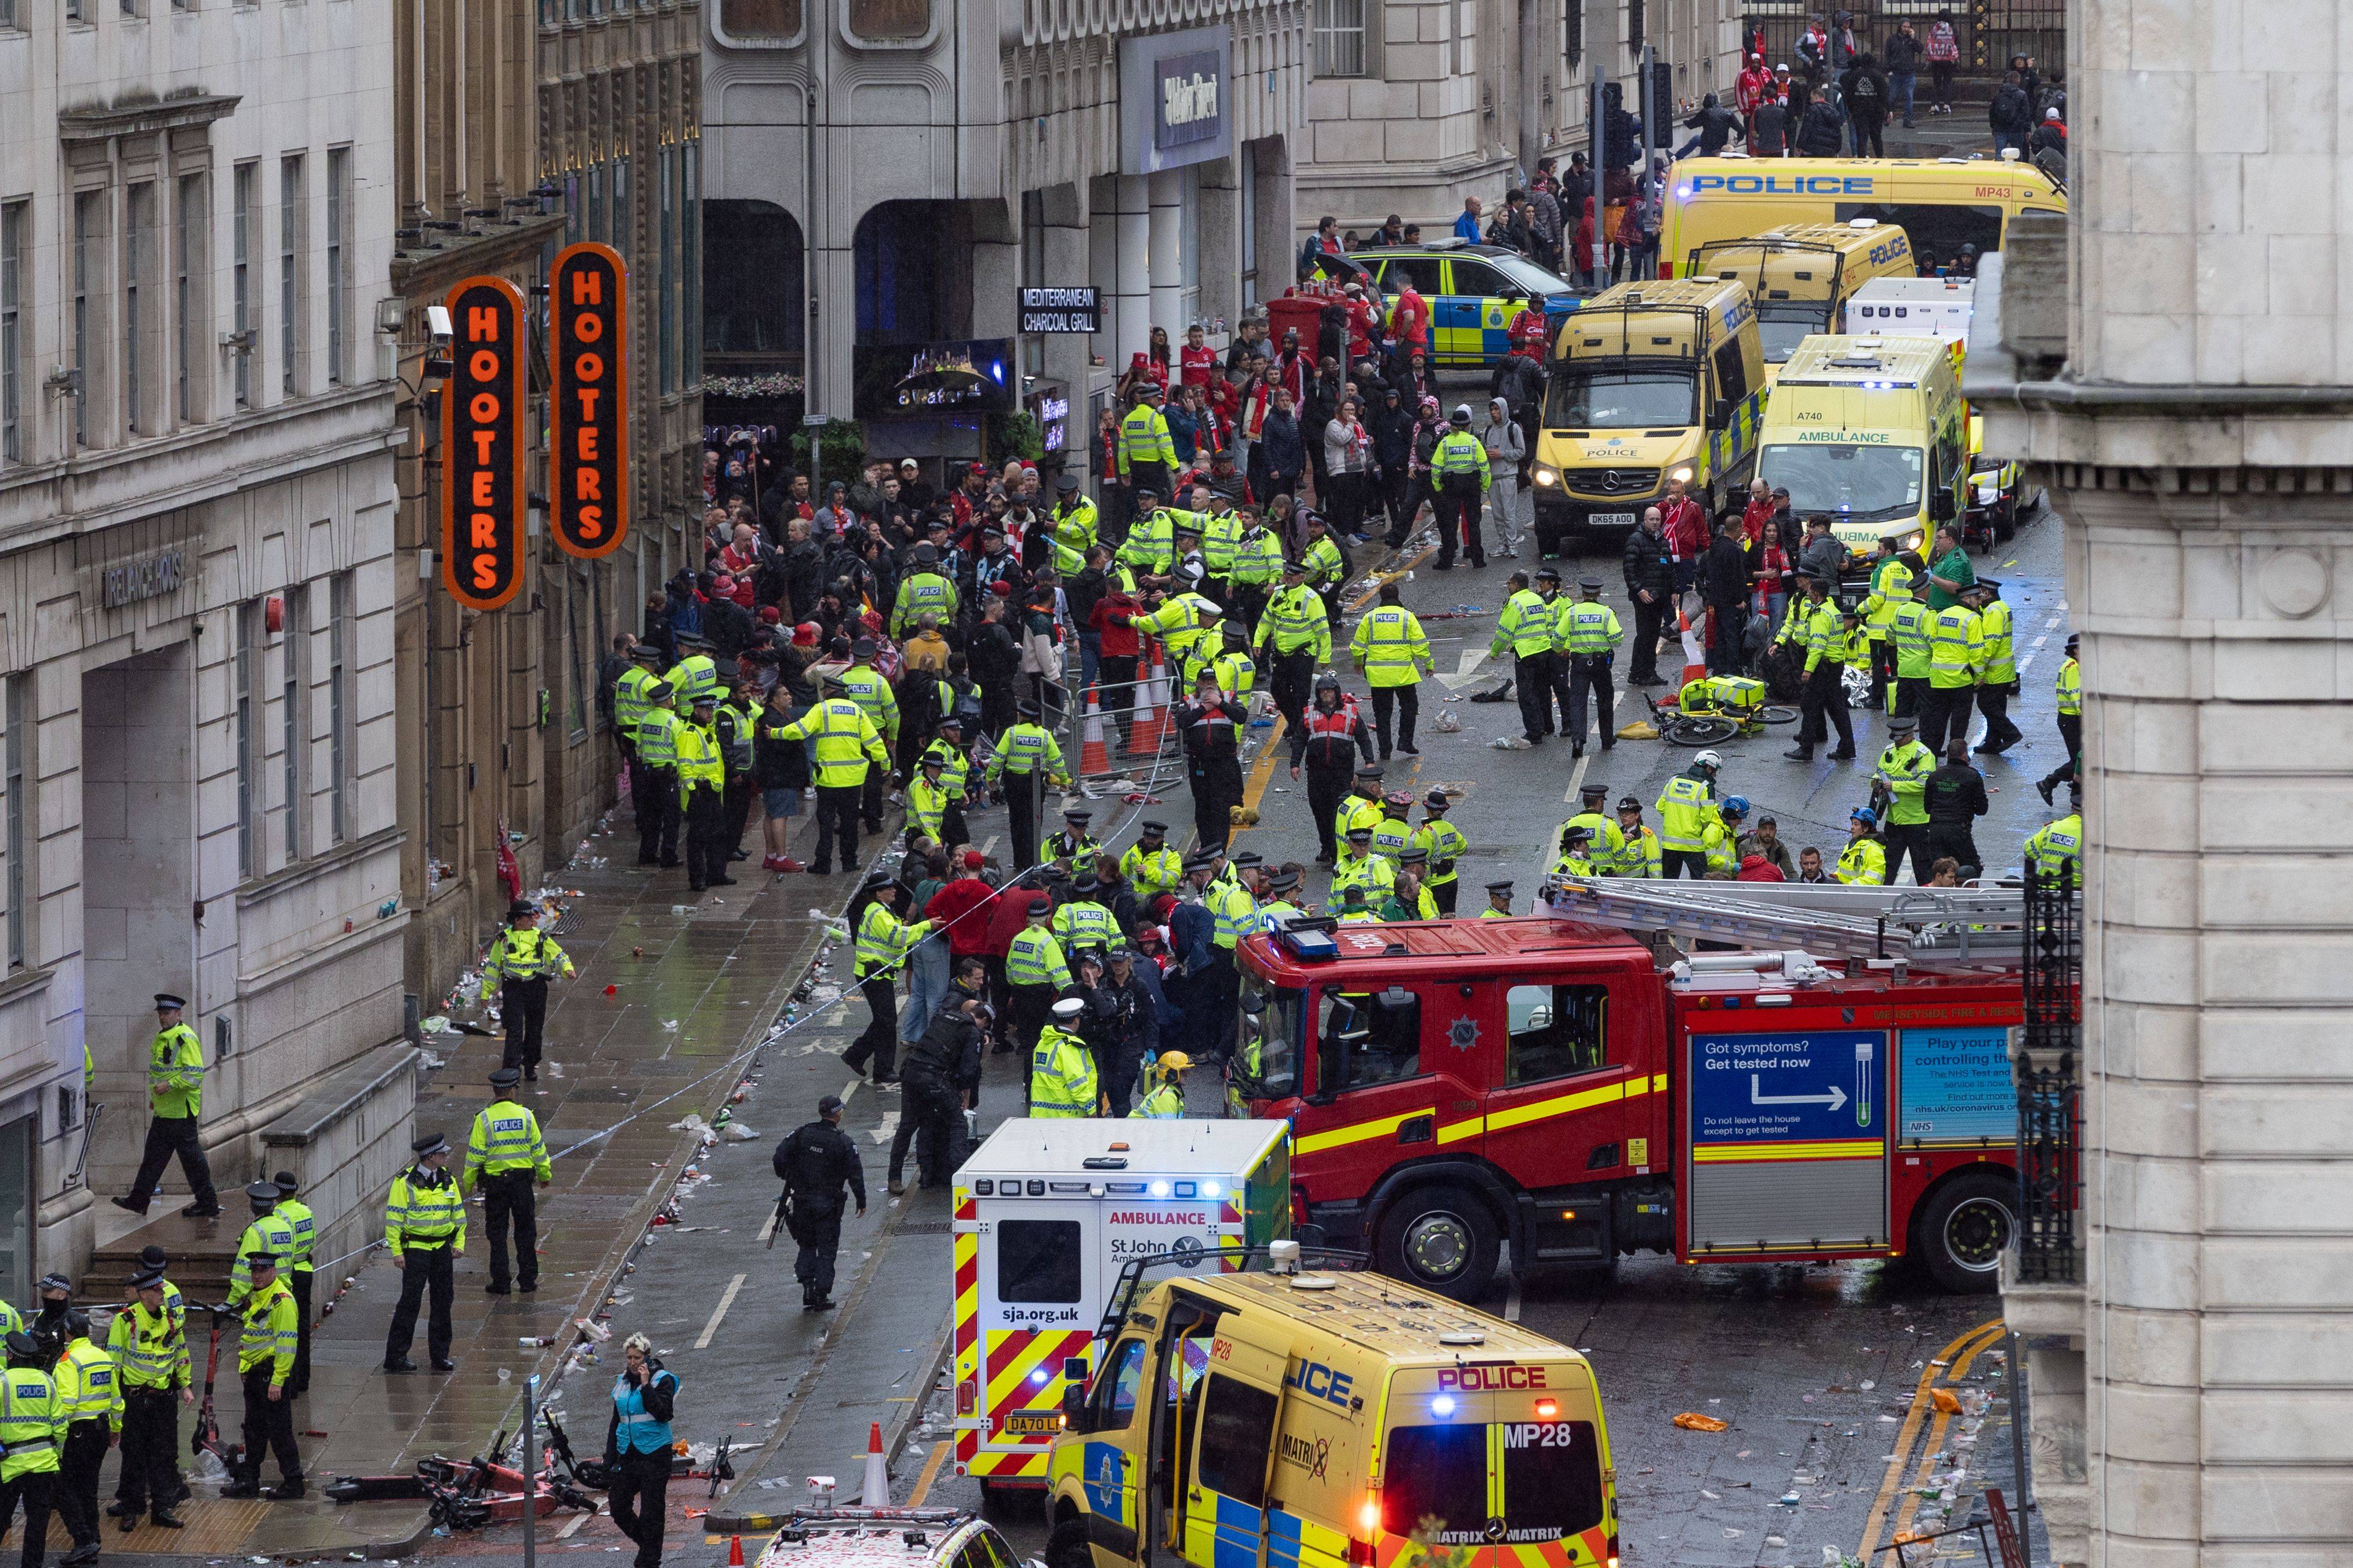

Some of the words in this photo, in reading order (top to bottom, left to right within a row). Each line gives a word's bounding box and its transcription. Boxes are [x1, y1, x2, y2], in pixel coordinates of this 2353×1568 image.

[1692, 176, 1873, 194] POLICE
[1975, 187, 2010, 198] MP43
[1869, 236, 1907, 268] POLICE
[1024, 289, 1094, 306] MEDITERRANEAN
[1724, 298, 1752, 333] POLICE
[1024, 313, 1069, 331] CHARCOAL
[1071, 313, 1095, 331] GRILL
[912, 388, 965, 405] Water
[573, 271, 604, 539] HOOTERS
[1798, 432, 1889, 443] AMBULANCE
[469, 306, 500, 590] HOOTERS
[1592, 515, 1613, 524] DK65
[918, 587, 940, 596] POLICE
[1528, 605, 1544, 614] POLICE
[1899, 617, 1913, 626] POLICE
[1941, 617, 1958, 627] POLICE
[1241, 663, 1252, 671] POLICE
[696, 670, 714, 680] POLICE
[642, 725, 662, 734] POLICE
[1018, 736, 1041, 746] POLICE
[1378, 835, 1403, 847] POLICE
[2051, 834, 2075, 846] POLICE
[1078, 911, 1102, 920] POLICE
[1015, 941, 1034, 953] POLICE
[1874, 1009, 1948, 1020] MERSEYSIDE
[1952, 1008, 1976, 1018] FIRE
[1980, 1007, 1987, 1016] &
[1990, 1006, 2024, 1017] RESC
[1705, 1043, 1729, 1054] Got
[1733, 1041, 1809, 1056] symptoms?
[1928, 1038, 1956, 1050] Play
[1961, 1039, 1992, 1050] your
[1705, 1058, 1730, 1069] Get
[1734, 1057, 1777, 1069] tested
[1781, 1059, 1810, 1068] now
[1915, 1054, 1989, 1066] controlling
[1944, 1080, 1974, 1089] service
[1948, 1093, 1967, 1101] Find
[1915, 1104, 2005, 1113] nhs.uk/coronavirus
[494, 1120, 522, 1132] POLICE
[1704, 1127, 1733, 1136] except
[1746, 1127, 1759, 1135] get
[1762, 1126, 1788, 1134] tested
[1911, 1122, 1931, 1130] NHS
[1110, 1213, 1205, 1224] AMBULANCE
[272, 1233, 291, 1244] POLICE
[1111, 1239, 1128, 1253] St
[1130, 1239, 1167, 1253] John
[1003, 1307, 1079, 1320] sja.org.uk
[1211, 1337, 1232, 1360] MP28
[1437, 1367, 1546, 1391] POLICE
[17, 1386, 46, 1397] POLICE
[1011, 1419, 1043, 1431] DA70
[1504, 1424, 1571, 1448] MP28
[1282, 1430, 1334, 1485] MATRIX
[1506, 1527, 1563, 1541] MATRIX
